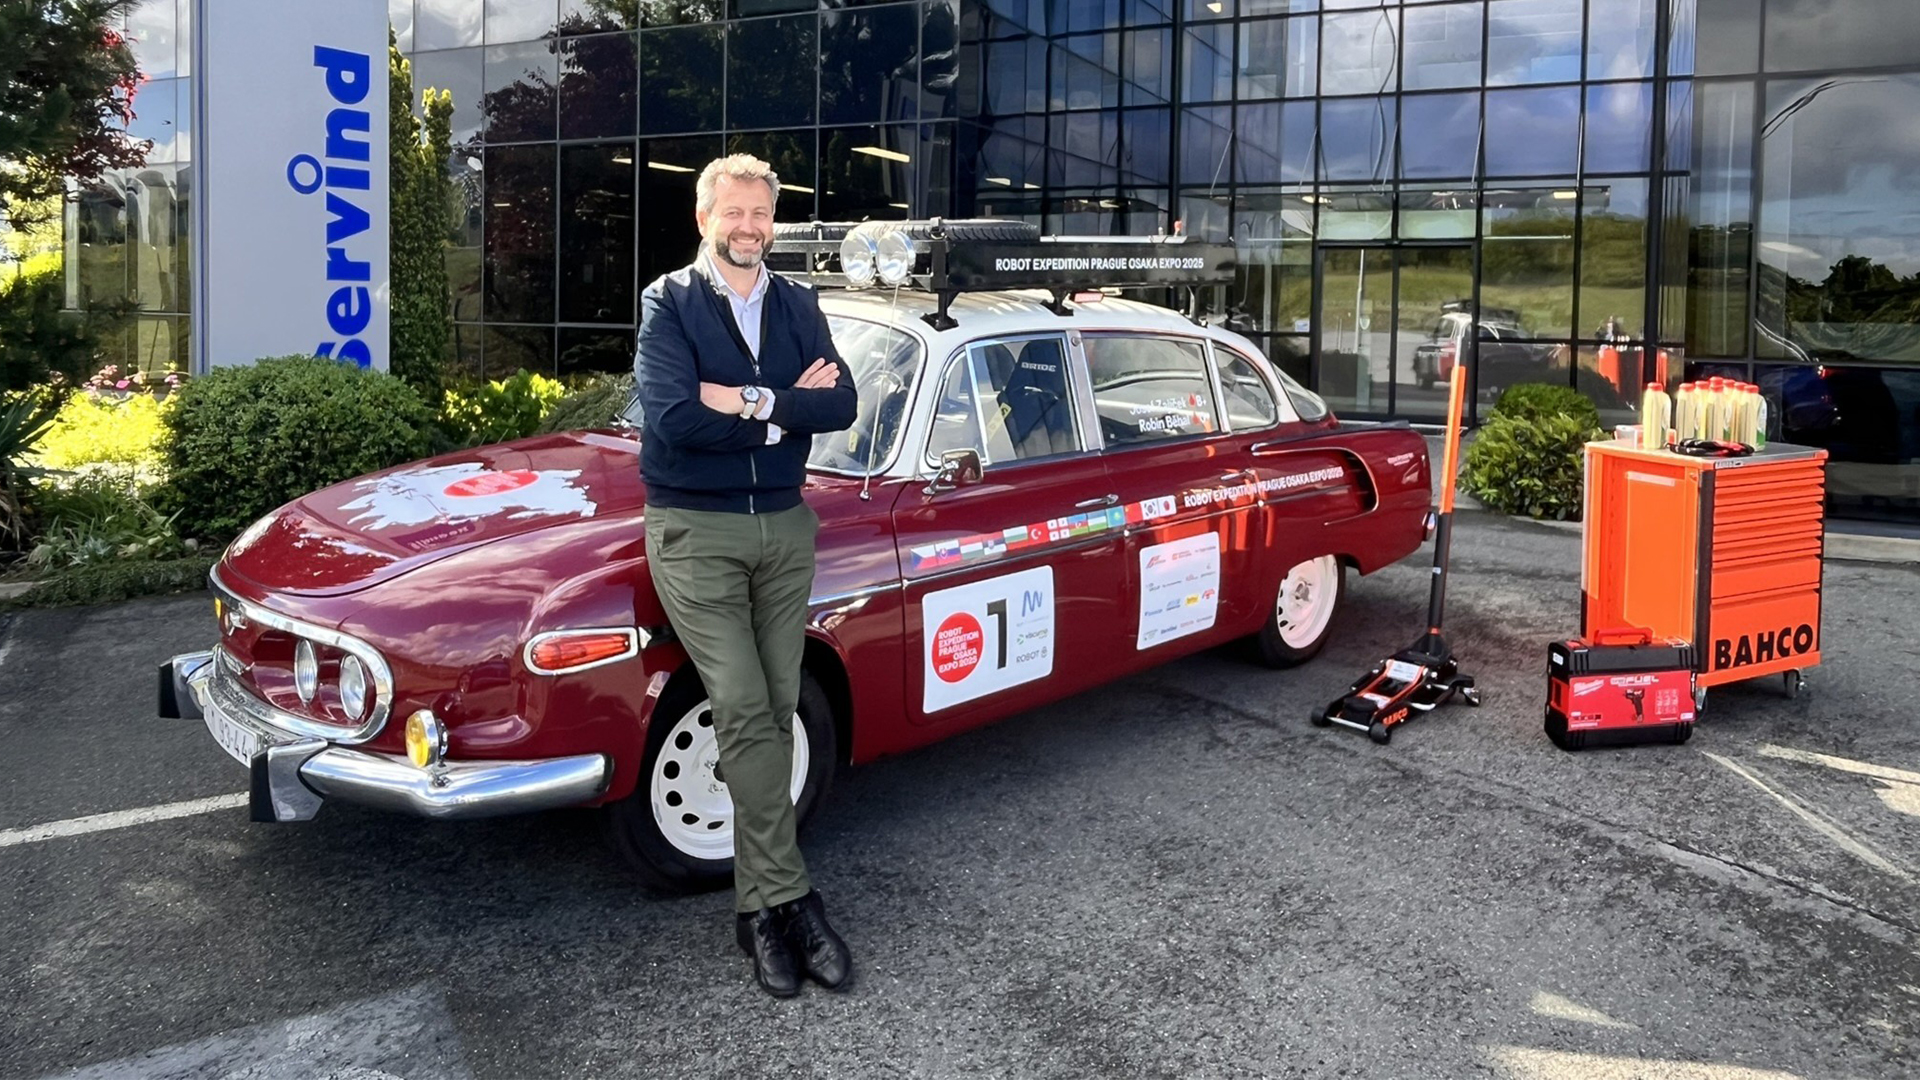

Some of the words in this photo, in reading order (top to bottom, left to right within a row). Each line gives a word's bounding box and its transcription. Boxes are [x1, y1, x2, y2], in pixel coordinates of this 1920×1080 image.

[287, 45, 371, 369] Servind
[996, 258, 1031, 271] ROBOT
[1033, 258, 1090, 271] EXPEDITION
[1091, 258, 1127, 270] PRAGUE
[1128, 258, 1158, 270] OSAKA
[1159, 258, 1181, 269] EXPO
[1182, 257, 1204, 269] 2025
[1021, 361, 1056, 372] BRIDE
[1138, 416, 1165, 432] Robin
[1184, 491, 1213, 508] ROBOT
[1213, 485, 1258, 503] EXPEDITION
[1257, 479, 1287, 496] PRAGUE
[1286, 474, 1310, 488] OSAKA
[1310, 470, 1328, 483] EXPO
[938, 627, 963, 640] ROBOT
[986, 598, 1007, 670] 1
[1715, 623, 1814, 670] BAHCO
[1016, 649, 1040, 663] ROBOT
